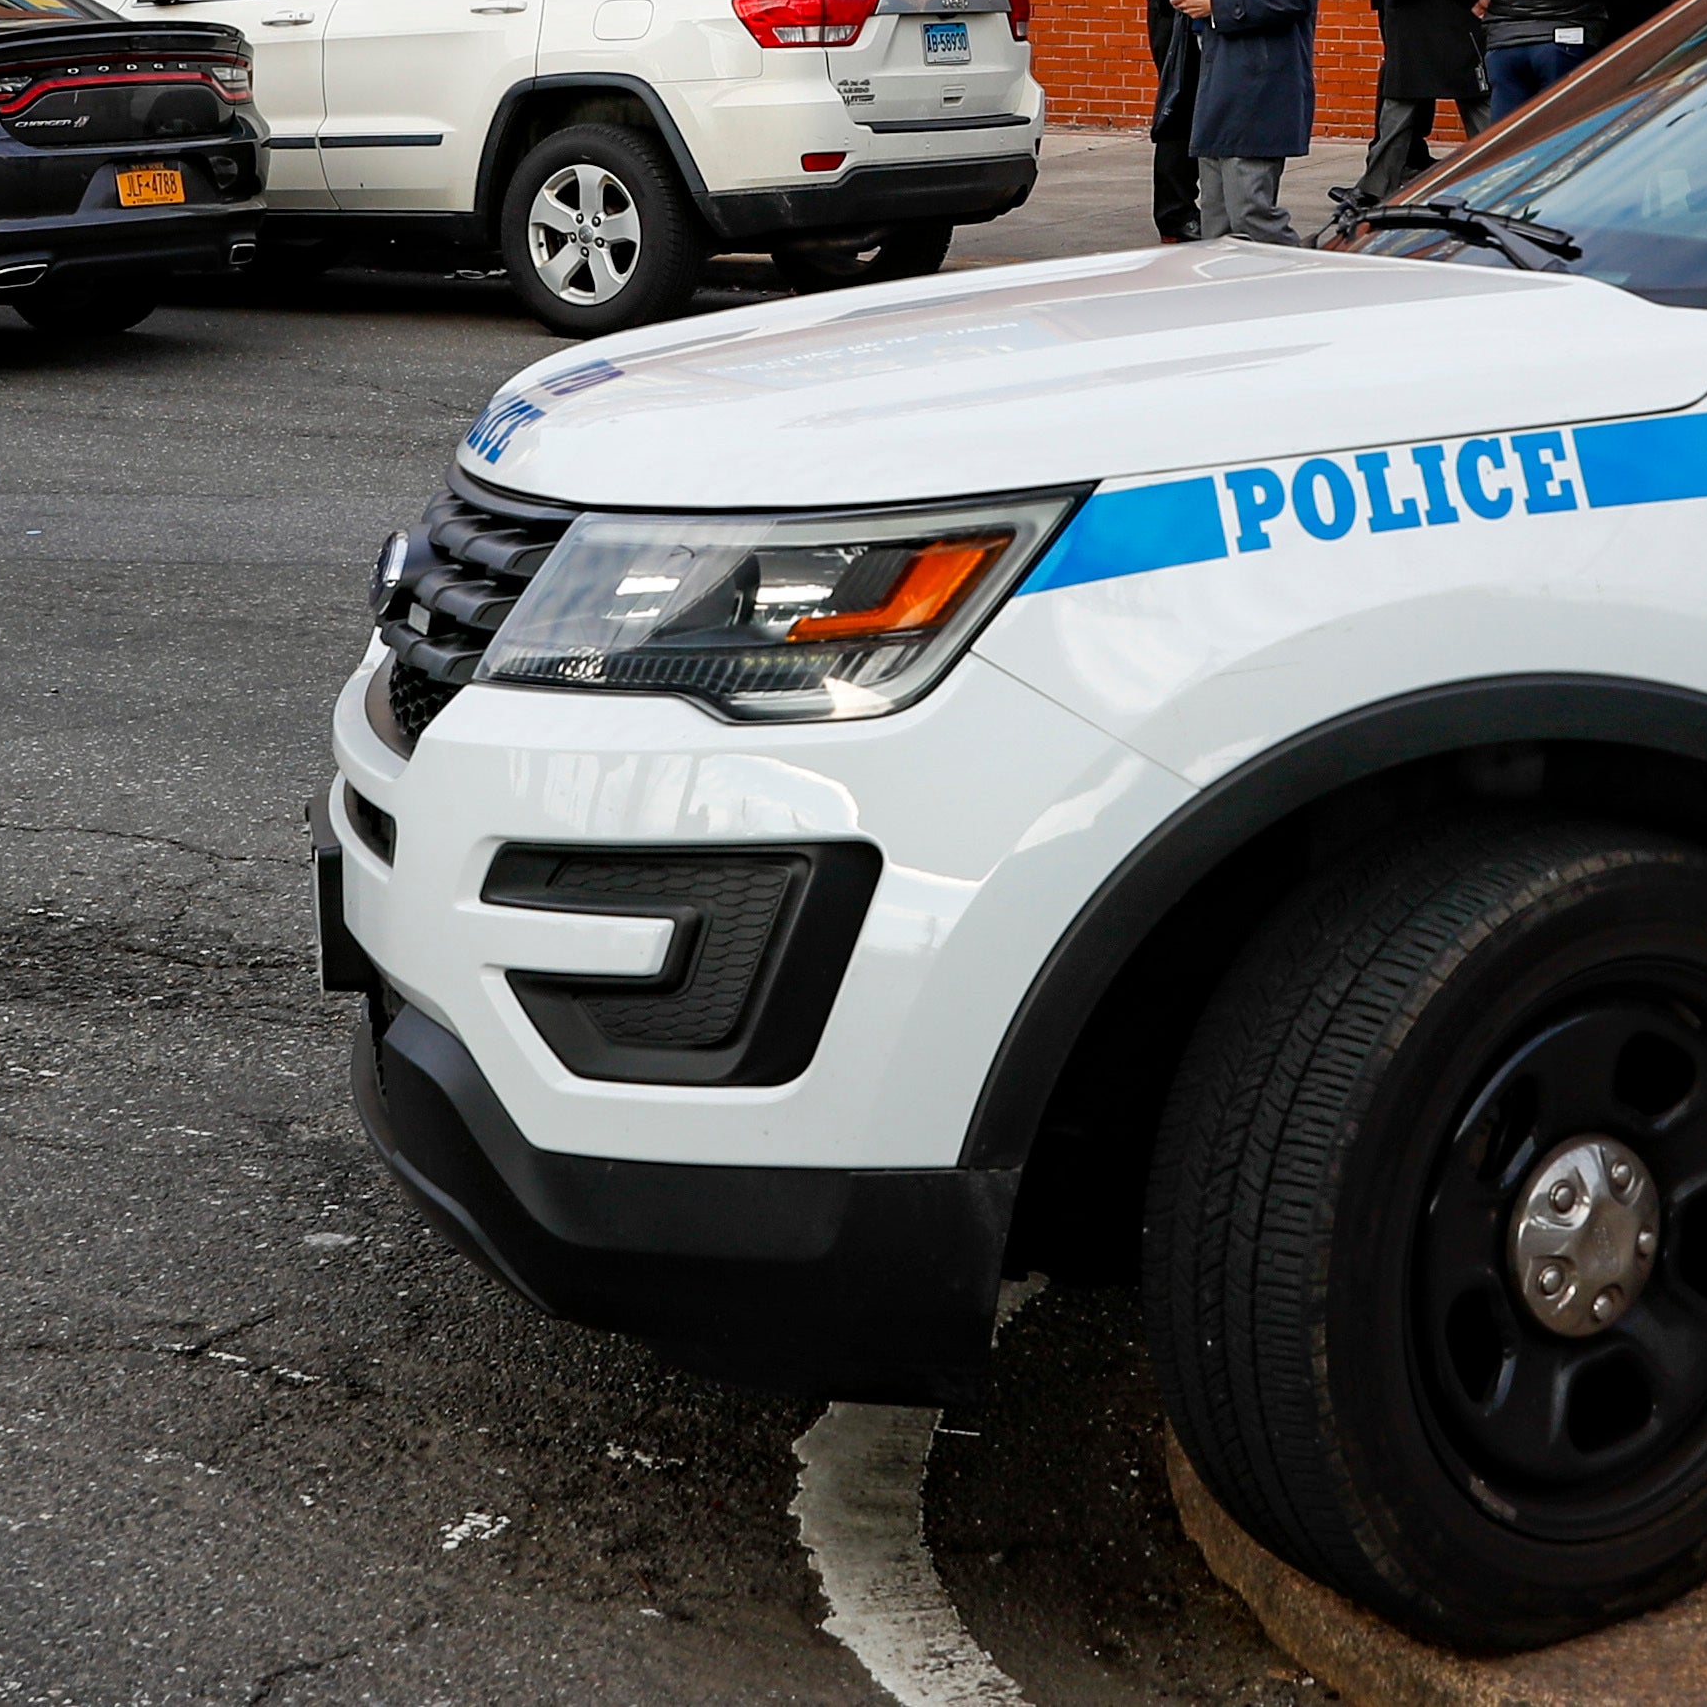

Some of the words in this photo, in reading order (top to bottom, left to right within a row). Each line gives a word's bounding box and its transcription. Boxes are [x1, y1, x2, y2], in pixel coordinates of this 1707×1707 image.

[66, 62, 189, 75] DODGE
[14, 118, 72, 128] CHARGER
[1223, 429, 1580, 555] POLICE
